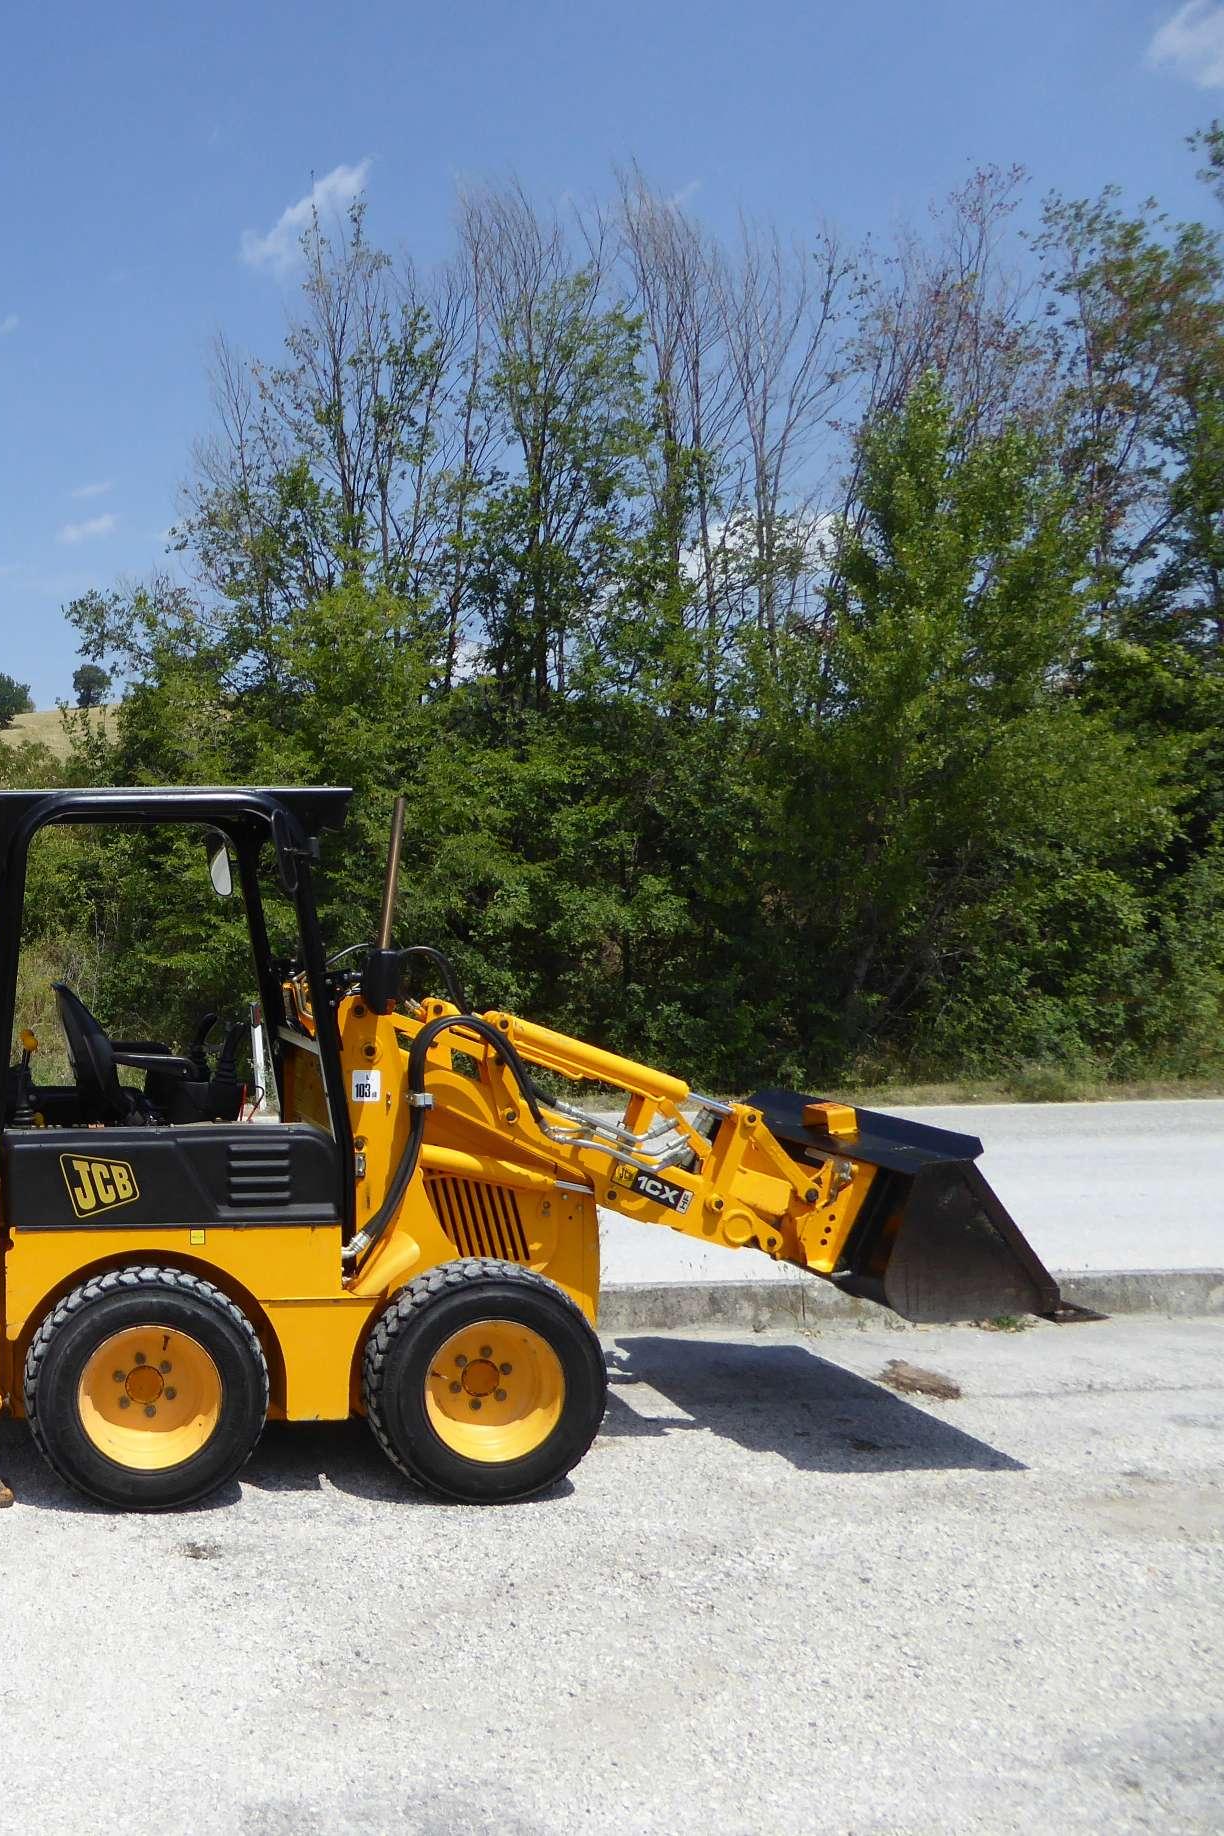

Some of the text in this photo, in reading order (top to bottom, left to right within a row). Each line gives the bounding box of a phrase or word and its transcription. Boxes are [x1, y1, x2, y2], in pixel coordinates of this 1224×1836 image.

[354, 1083, 371, 1098] 103
[72, 1160, 133, 1210] JCB
[637, 1175, 680, 1204] 1CX
[679, 1193, 690, 1210] HF
